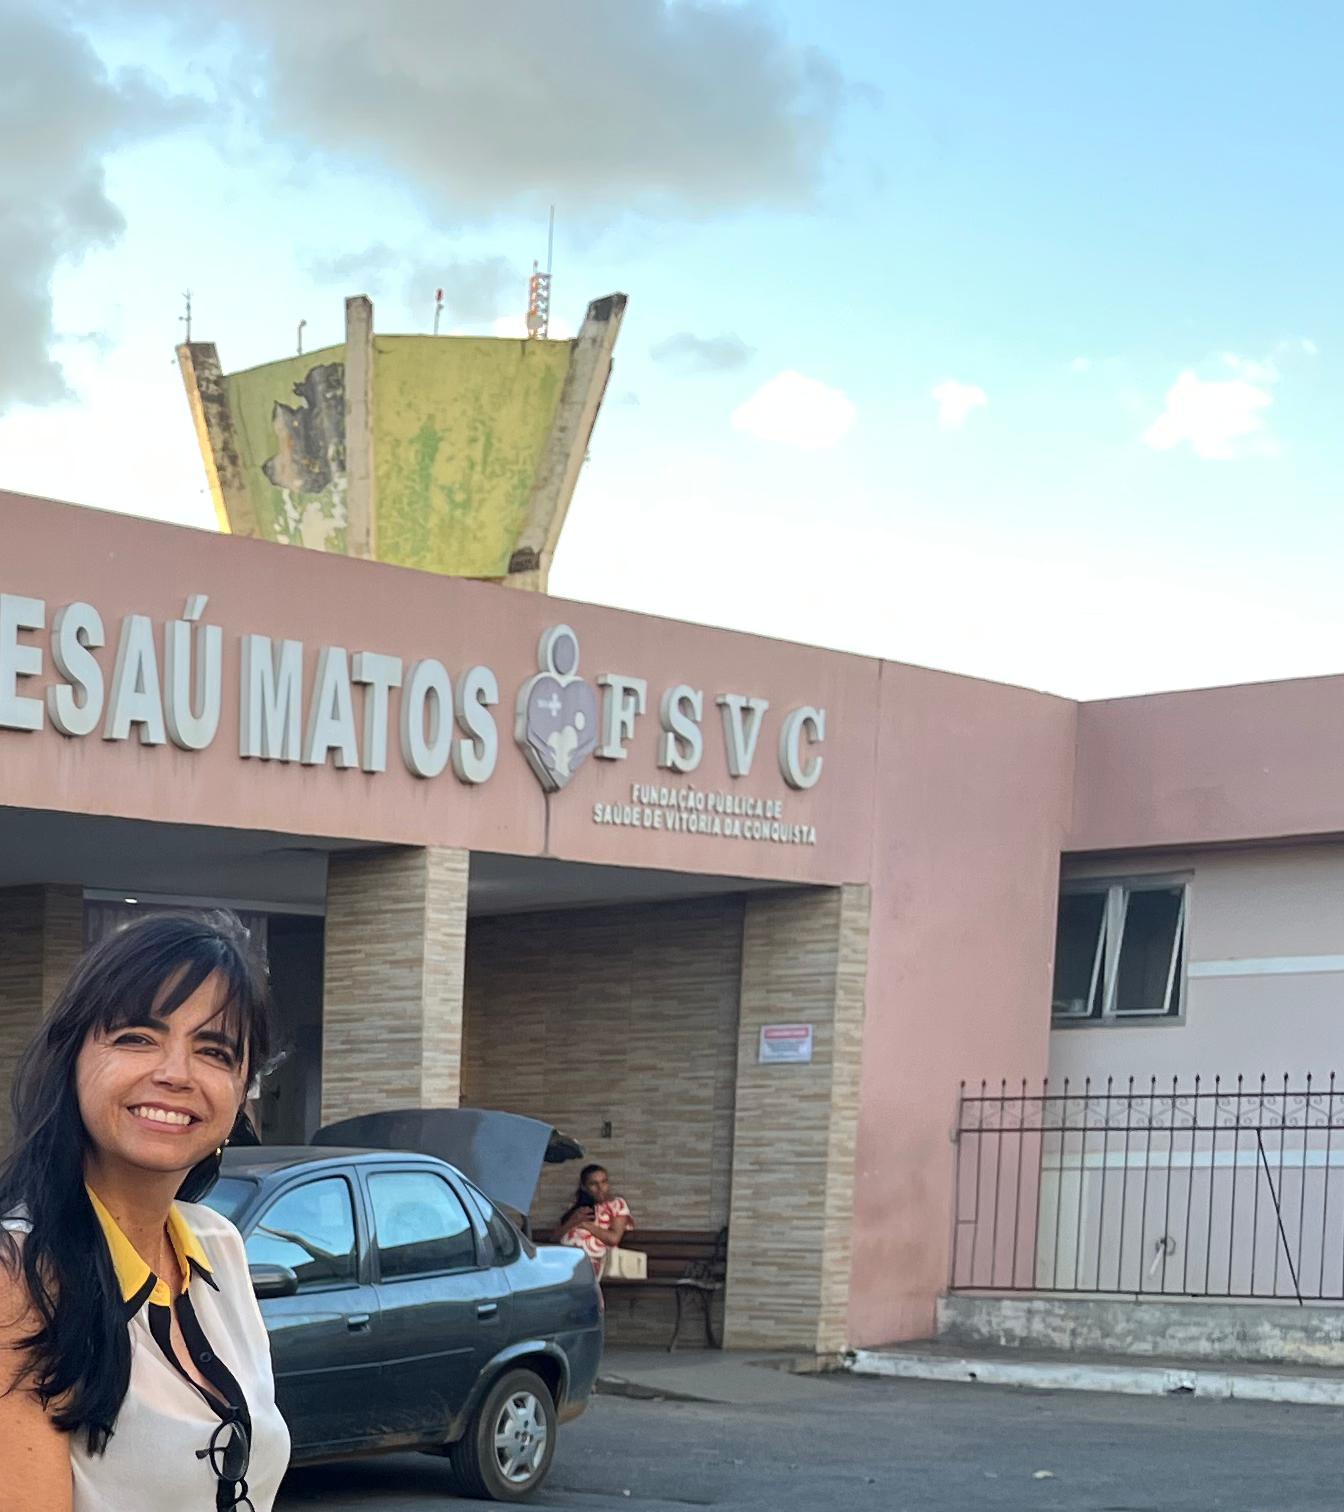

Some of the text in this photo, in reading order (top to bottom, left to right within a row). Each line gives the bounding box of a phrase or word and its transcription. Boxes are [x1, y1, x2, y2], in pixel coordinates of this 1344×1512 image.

[239, 634, 498, 785] MATOS
[643, 807, 662, 830] DE
[722, 816, 741, 839] DA
[742, 820, 816, 846] CONQUISTA
[765, 799, 783, 820] DE
